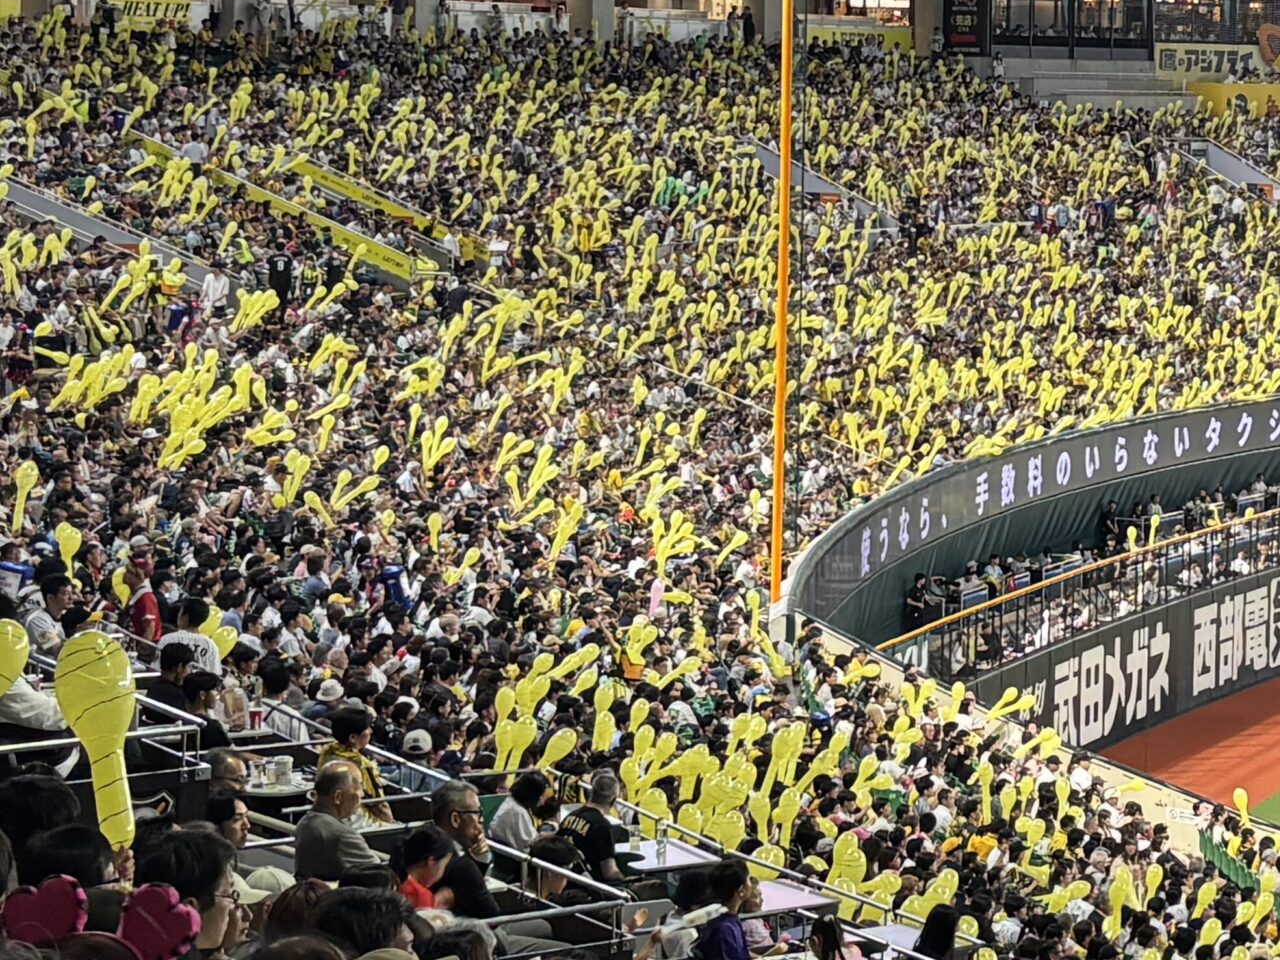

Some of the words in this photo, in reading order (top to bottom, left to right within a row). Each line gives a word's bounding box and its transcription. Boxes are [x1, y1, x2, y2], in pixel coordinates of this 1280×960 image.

[123, 1, 160, 17] HEAT
[164, 2, 191, 18] UP!
[1054, 621, 1171, 747] 武田メガネ
